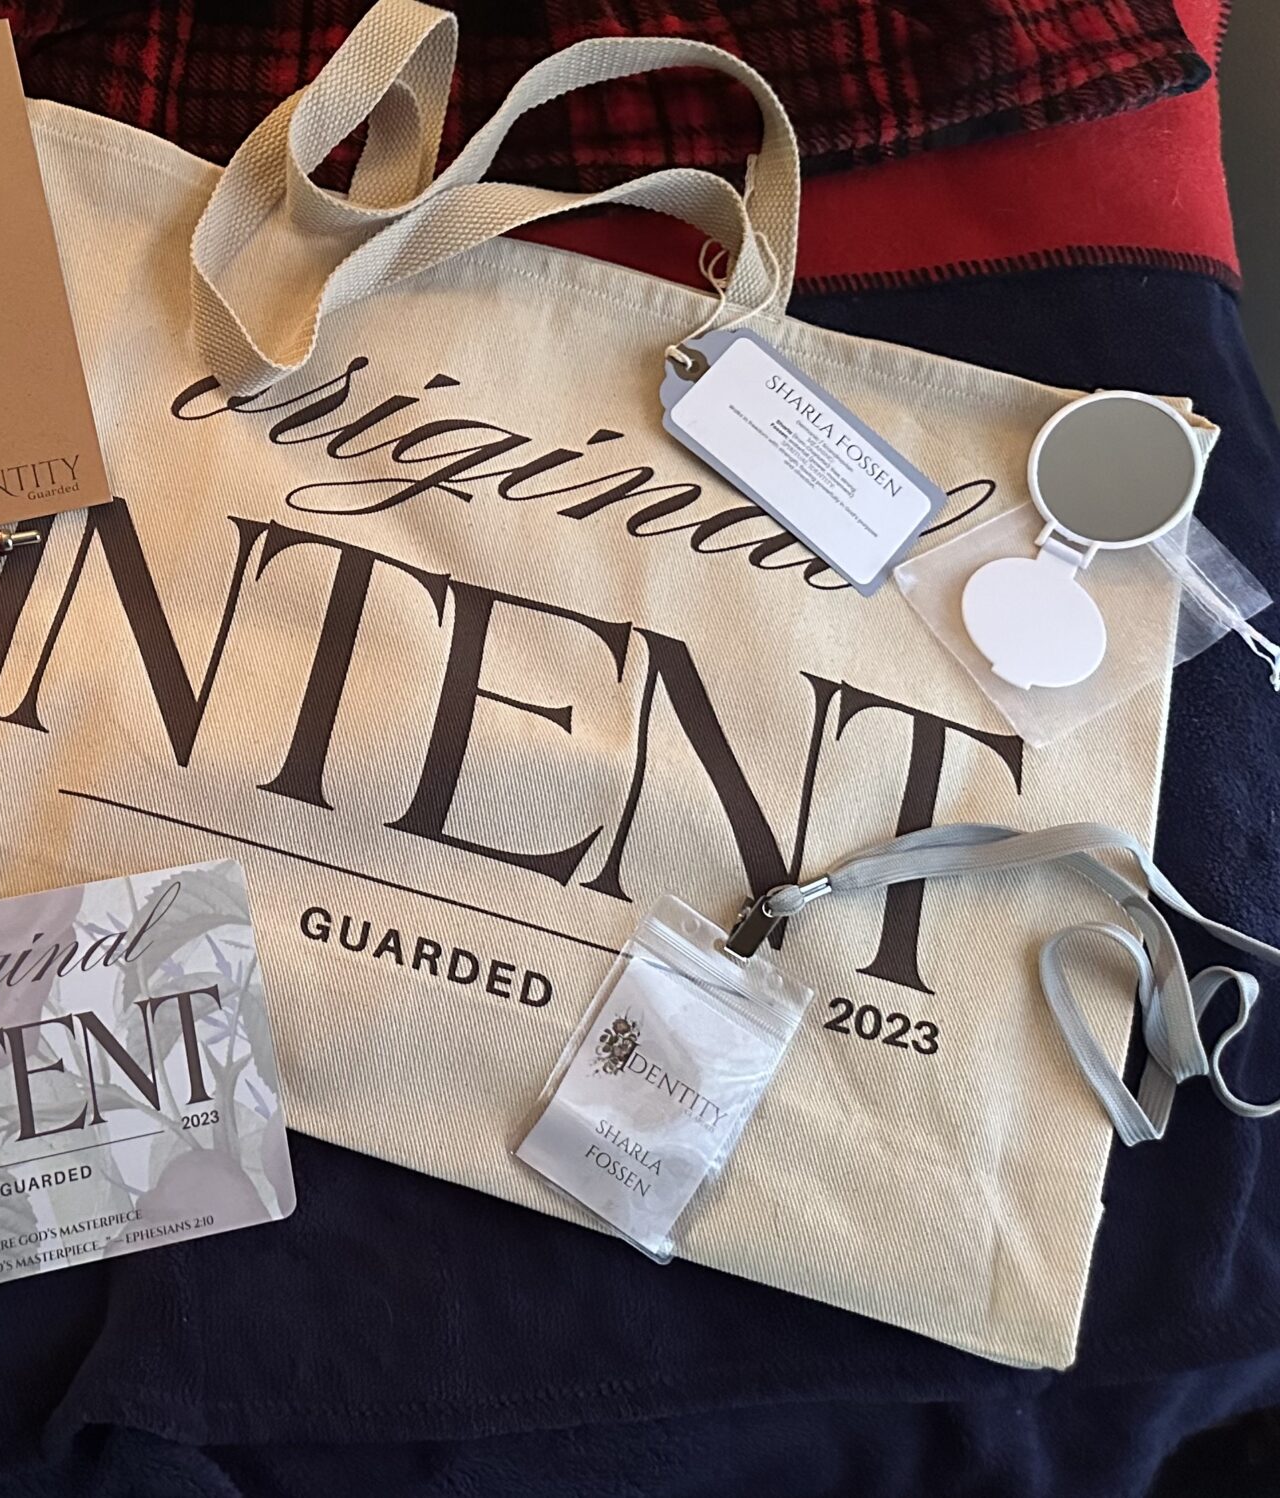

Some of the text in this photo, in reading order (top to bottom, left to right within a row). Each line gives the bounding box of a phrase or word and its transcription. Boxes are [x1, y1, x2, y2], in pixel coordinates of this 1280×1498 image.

[765, 374, 903, 497] SHARLA FOSSEN
[775, 419, 793, 435] Sharla
[27, 483, 80, 501] Guarded
[300, 907, 553, 1008] GUARDED
[823, 997, 939, 1055] 2023
[618, 1042, 728, 1127] IDENTITY
[181, 1110, 221, 1131] 2023
[595, 1119, 662, 1176] SHARLA
[0, 1165, 93, 1198] GUARDED
[585, 1144, 652, 1198] FOSSEN
[18, 1226, 58, 1247] GOD'S
[58, 1208, 143, 1238] MASTERPIECE
[124, 1221, 194, 1245] EPHESIANS
[193, 1214, 215, 1231] 2:10
